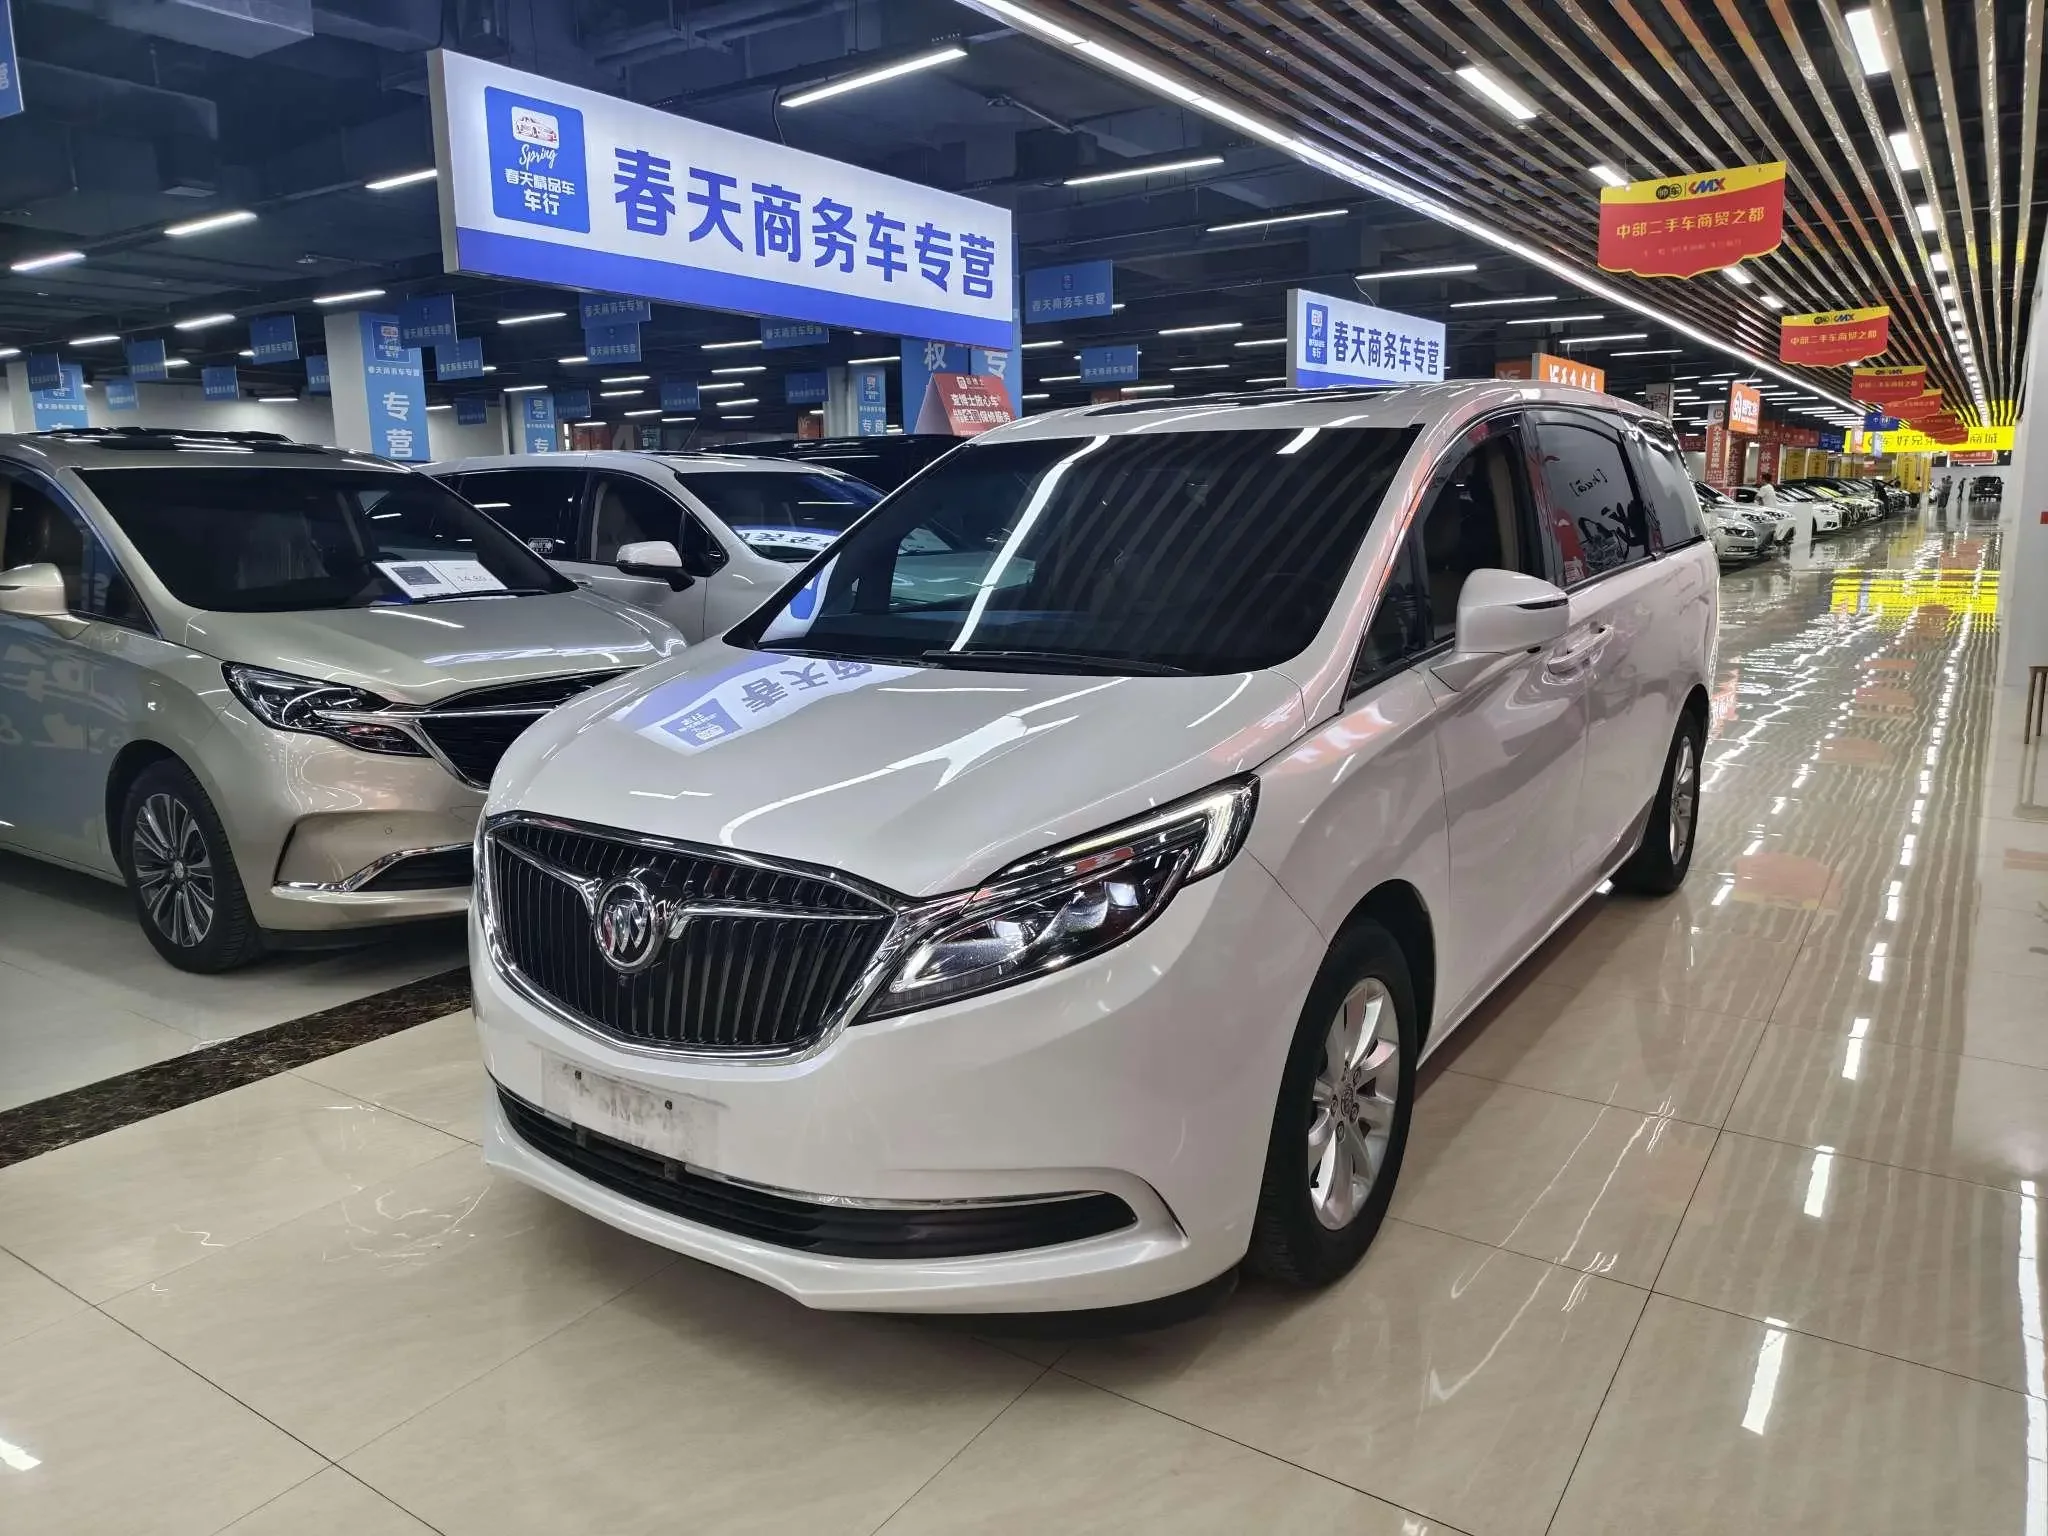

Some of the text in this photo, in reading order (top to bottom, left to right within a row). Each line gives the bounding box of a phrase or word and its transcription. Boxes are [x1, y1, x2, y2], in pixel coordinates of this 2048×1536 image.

[519, 143, 558, 170] Spring
[523, 188, 560, 216] 车行
[613, 147, 996, 299] 春天商务车专营
[1616, 206, 1765, 240] 中部二手车商贸之都
[1333, 320, 1439, 376] 春天商务车专营
[382, 391, 413, 458] 专营
